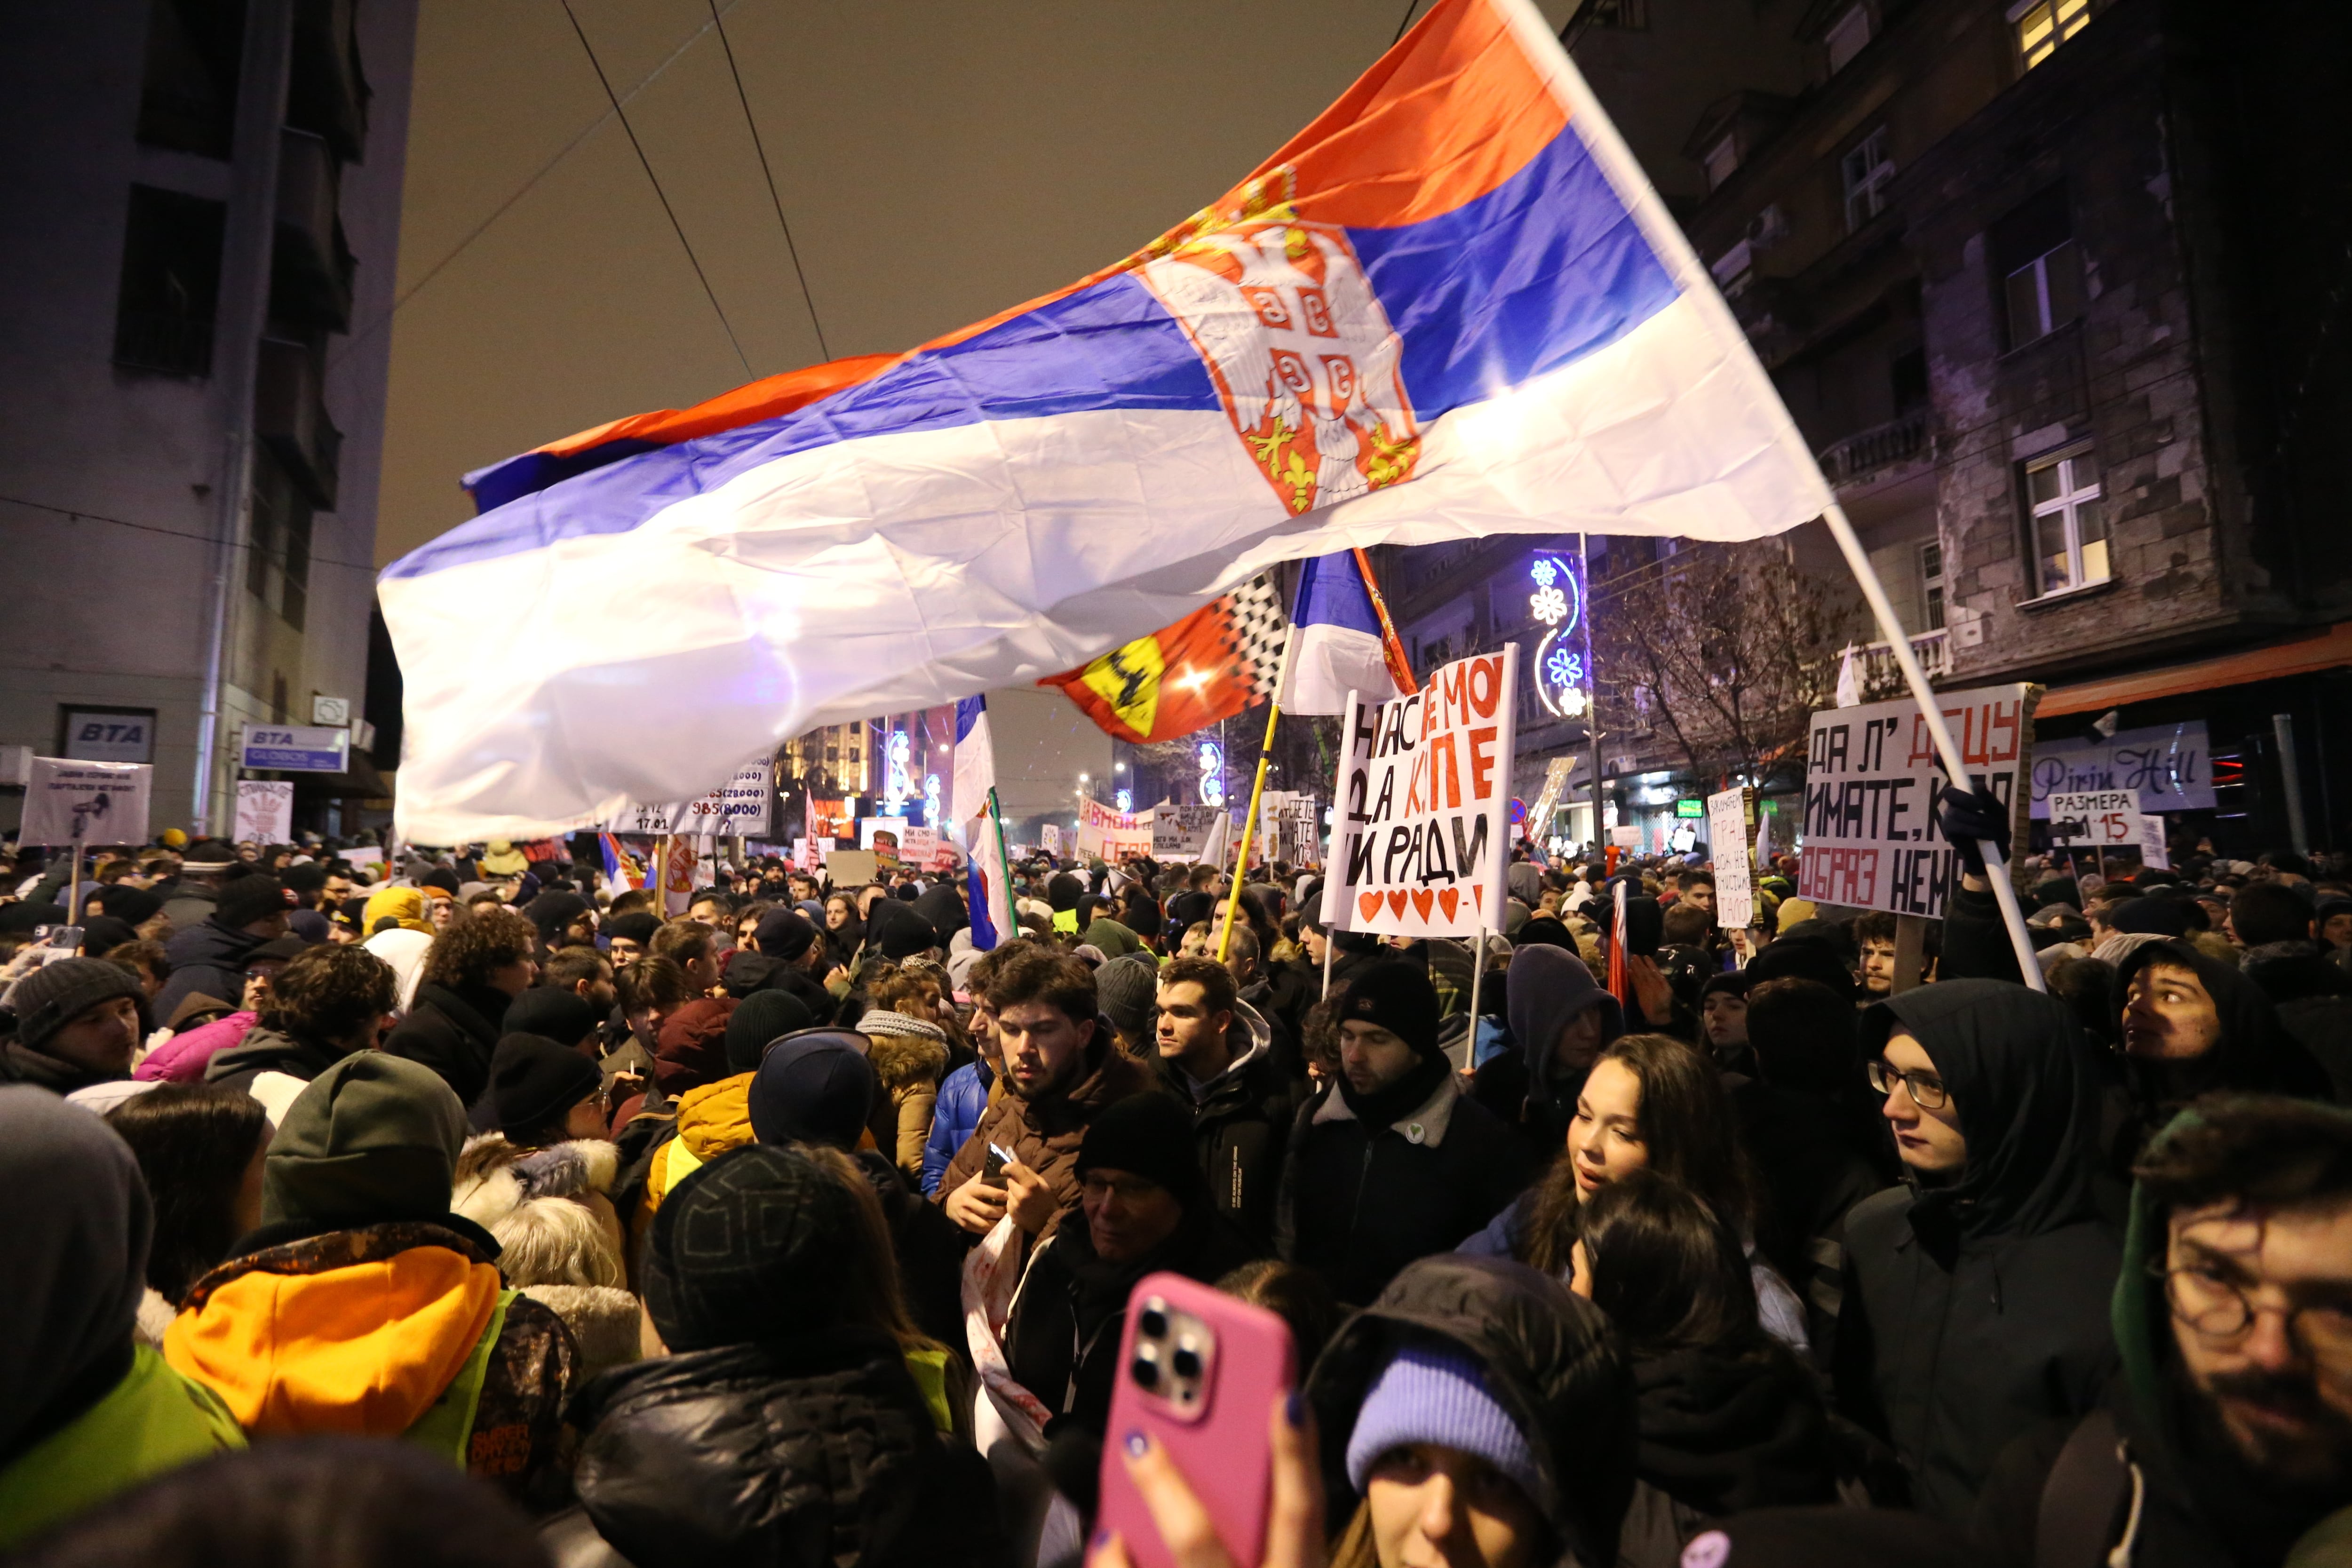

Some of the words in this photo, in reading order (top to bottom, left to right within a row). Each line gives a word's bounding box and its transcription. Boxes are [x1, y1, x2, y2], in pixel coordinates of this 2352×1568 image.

[79, 724, 143, 743] BTA
[253, 732, 293, 745] BTA
[1353, 695, 1420, 760] НАС
[1809, 724, 1850, 775] ДА
[1907, 699, 2021, 768] ДЦУ
[1347, 764, 1394, 826] ДА
[1404, 726, 1497, 819] КПЕ
[1804, 778, 1922, 843] ИМАТЕ,
[2054, 793, 2132, 812] РАЗМЕРА
[723, 819, 731, 833] ?
[905, 828, 914, 837] МИ
[1713, 818, 1746, 846] ГРАД
[1715, 853, 1732, 871] ДОК
[1734, 850, 1746, 868] НЕ
[1799, 846, 1879, 906] ОБРАЗ
